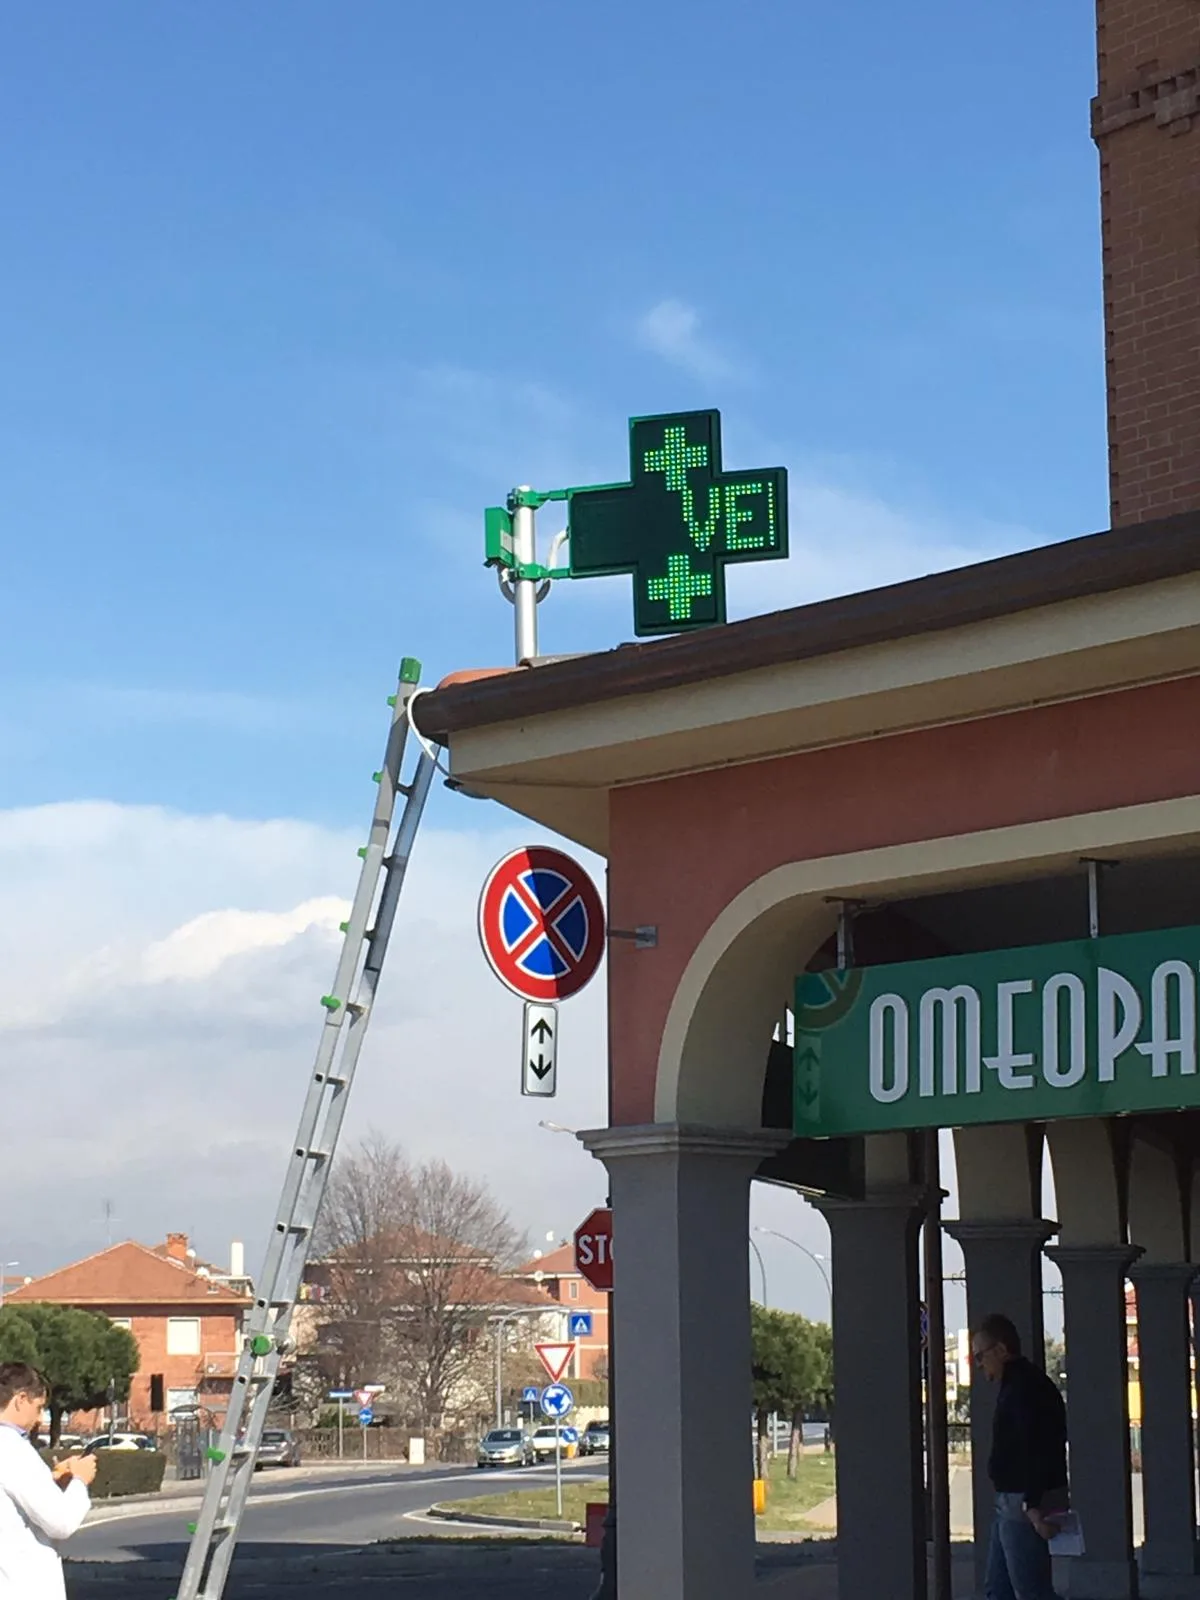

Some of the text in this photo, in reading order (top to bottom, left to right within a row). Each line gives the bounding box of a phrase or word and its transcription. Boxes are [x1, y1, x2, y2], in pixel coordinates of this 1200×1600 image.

[682, 482, 775, 552] VE
[869, 959, 1200, 1104] OMEOPA
[579, 1234, 613, 1265] ST
